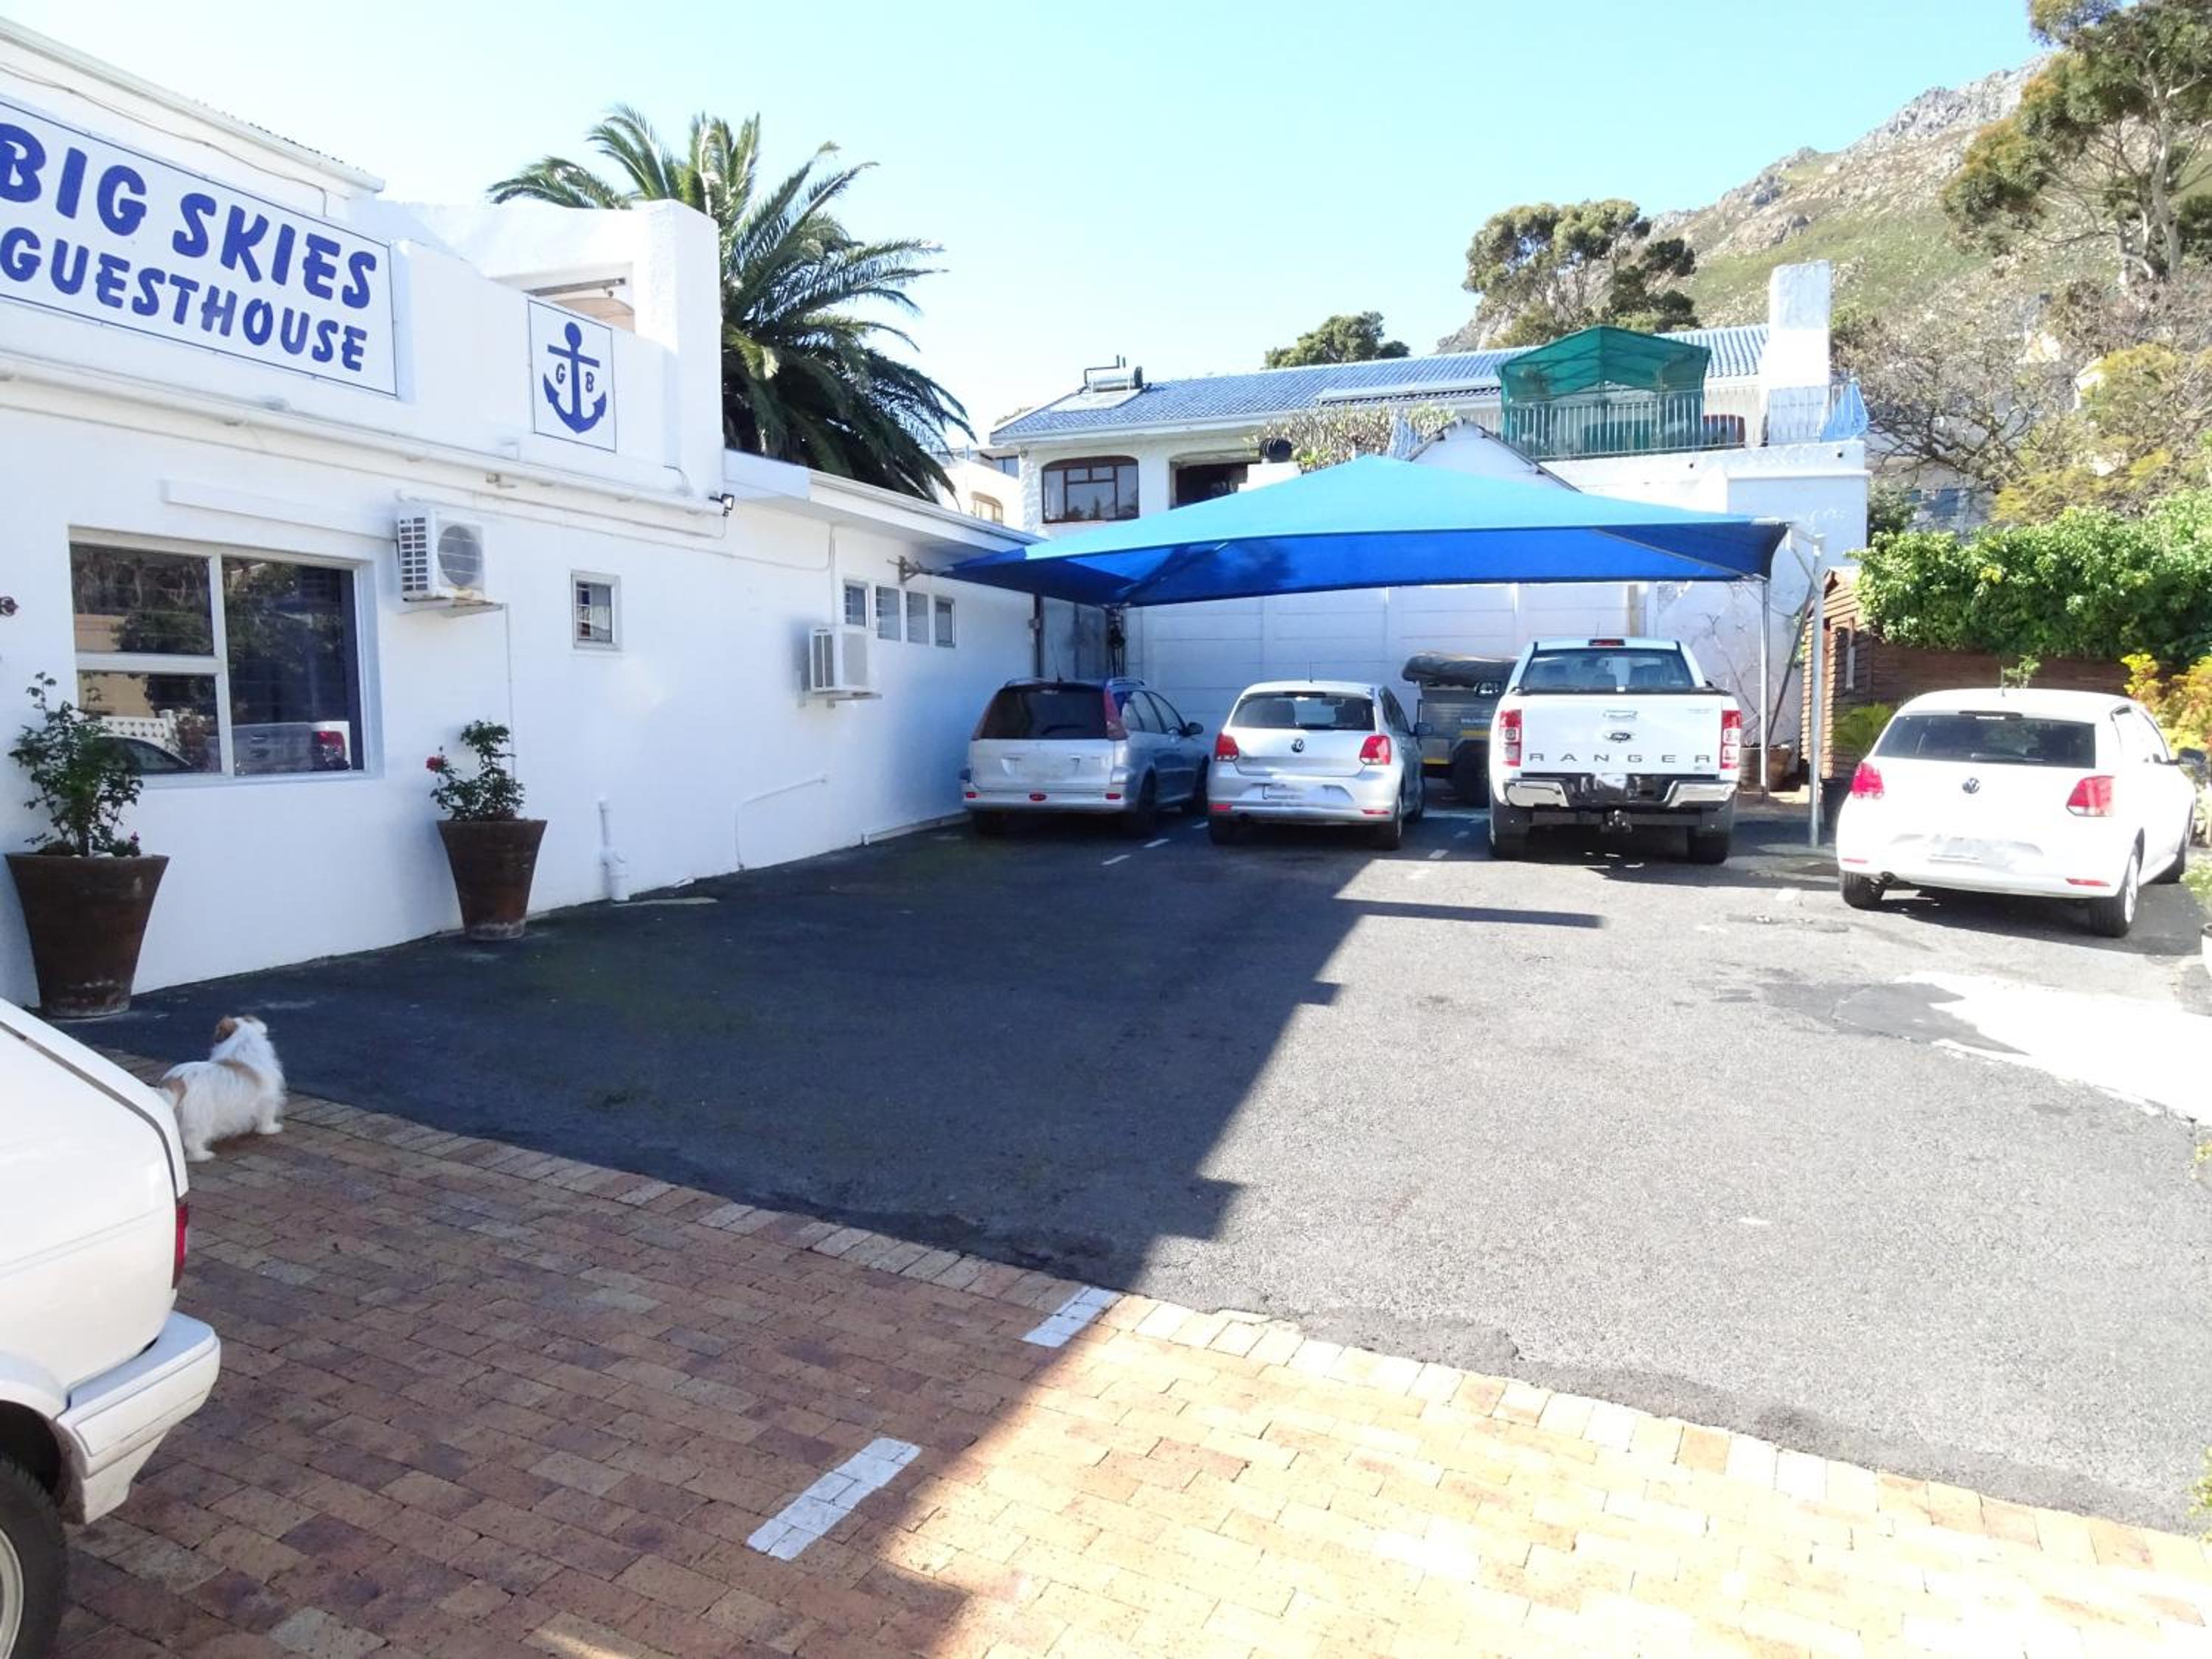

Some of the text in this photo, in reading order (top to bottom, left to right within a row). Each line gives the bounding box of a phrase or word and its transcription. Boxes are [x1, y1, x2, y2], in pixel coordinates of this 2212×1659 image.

[0, 122, 377, 309] BIG SKIES
[0, 227, 368, 372] GUESTHOUSE
[555, 363, 595, 393] G B
[1528, 753, 1711, 764] RANGER
